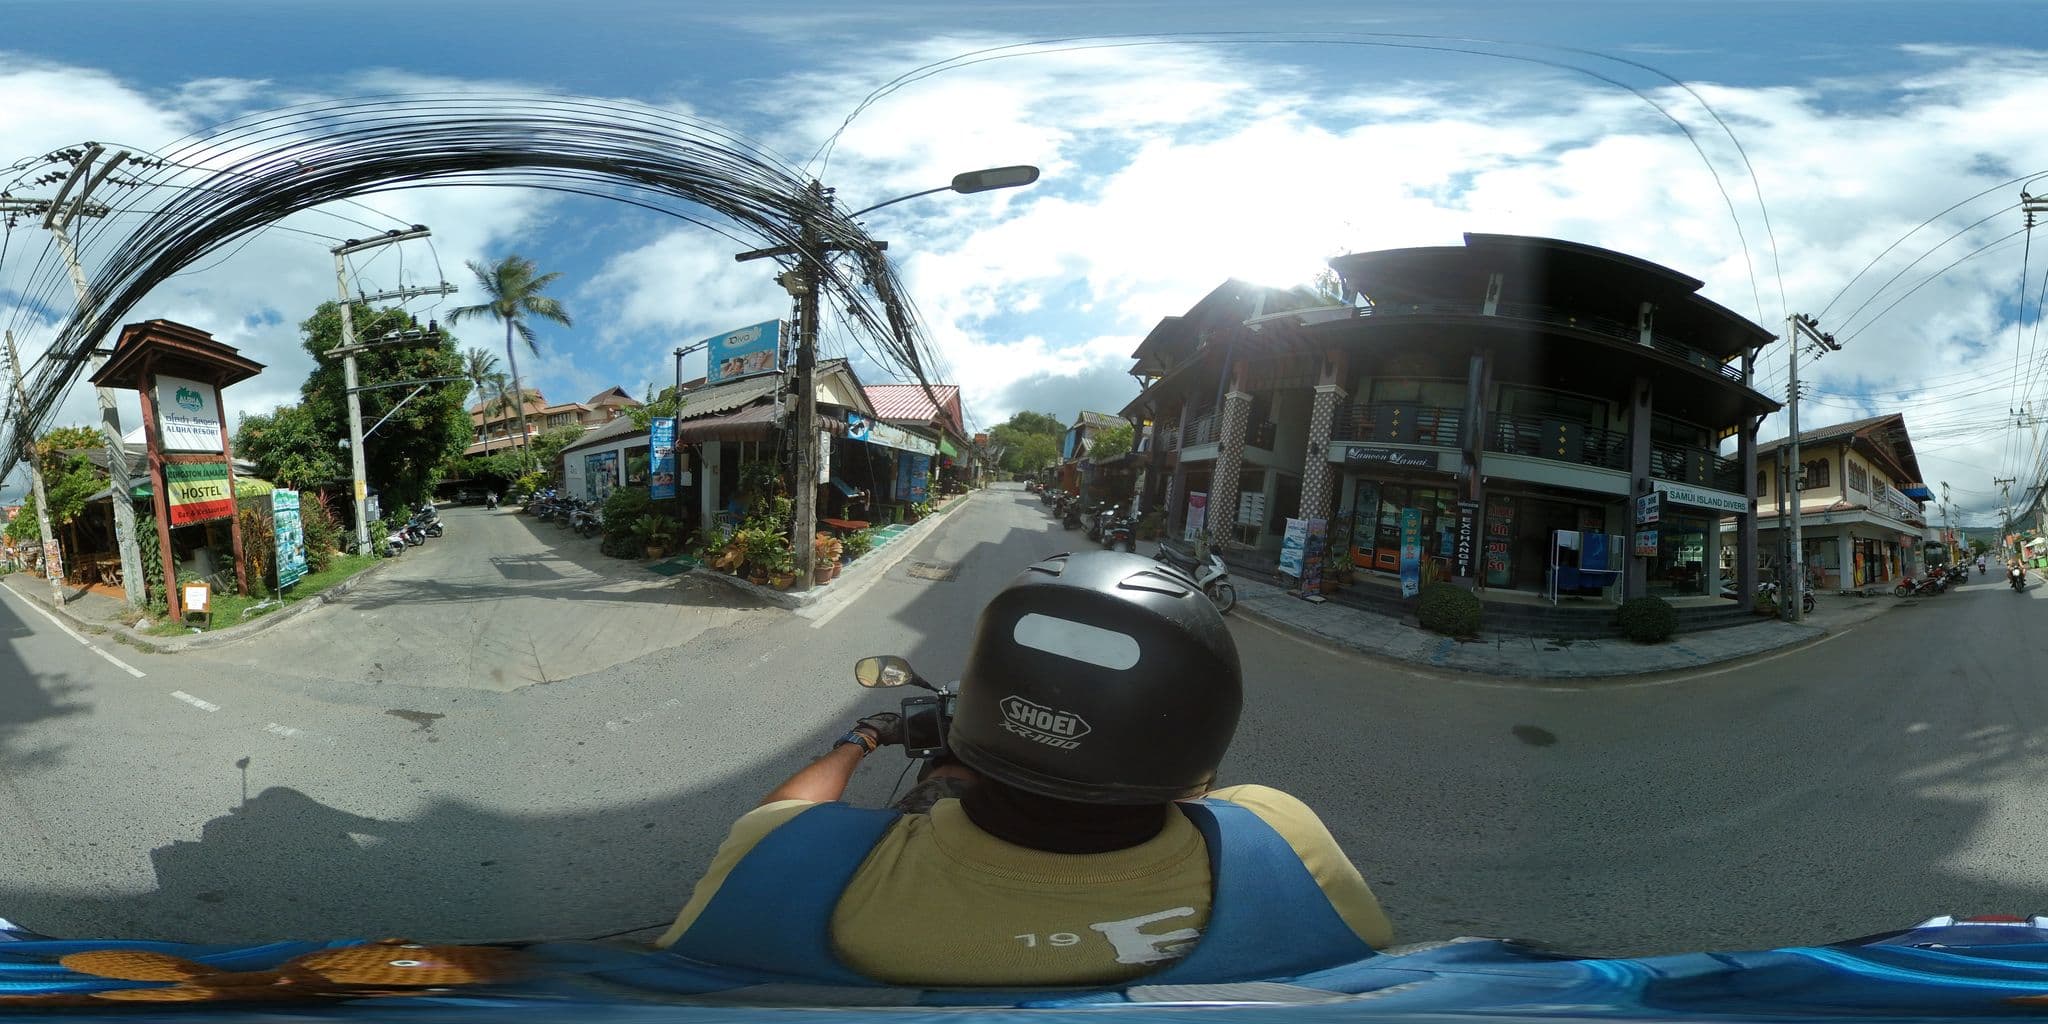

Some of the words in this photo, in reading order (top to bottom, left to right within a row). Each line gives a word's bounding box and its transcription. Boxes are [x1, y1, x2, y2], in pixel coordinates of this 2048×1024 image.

[167, 425, 192, 434] ALOHA
[193, 427, 219, 436] RESORT
[181, 485, 222, 499] HOSTEL
[1669, 490, 1695, 502] SAMUI
[1696, 494, 1721, 507] ISLAND
[1723, 500, 1746, 511] DIVERS
[1458, 516, 1473, 566] EXCHANGE
[1008, 700, 1077, 736] SHOEI
[998, 719, 1081, 750] XR-1100
[1014, 932, 1081, 948] 19
